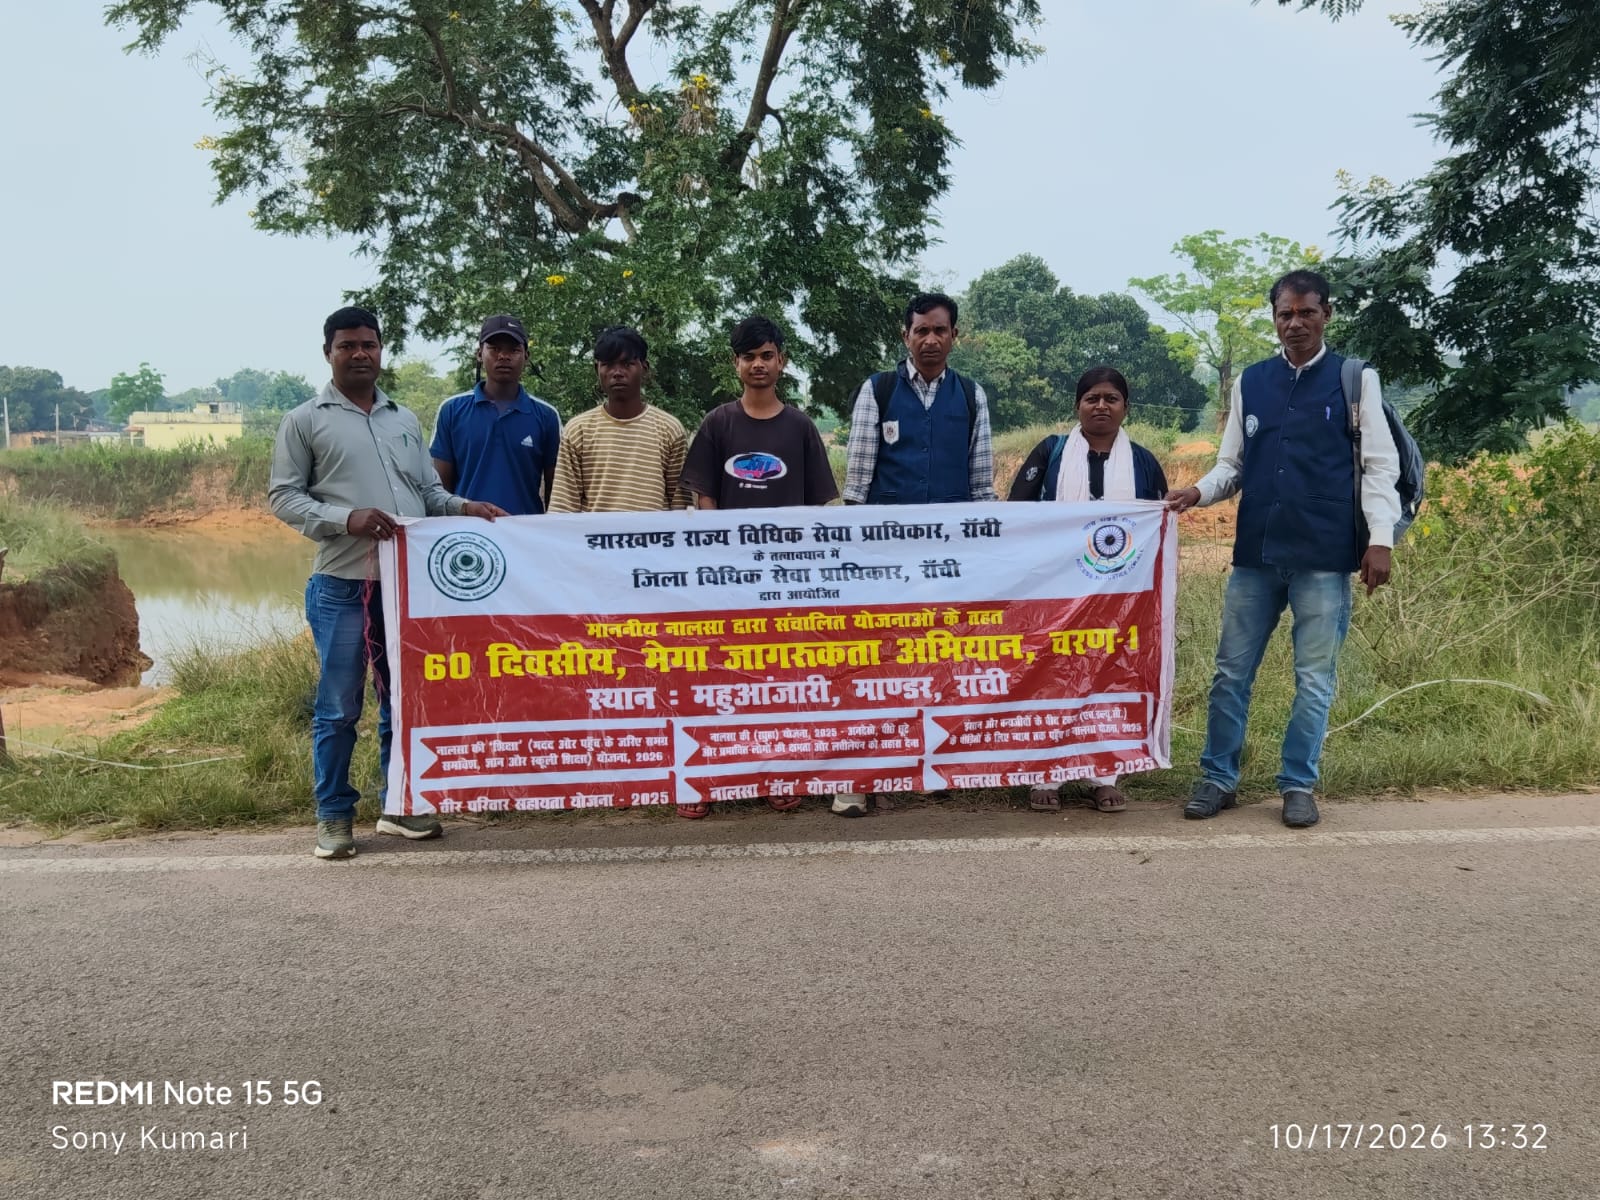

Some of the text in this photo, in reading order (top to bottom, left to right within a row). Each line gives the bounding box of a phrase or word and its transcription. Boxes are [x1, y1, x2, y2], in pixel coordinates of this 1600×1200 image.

[585, 532, 675, 550] झारखण्ड
[682, 530, 731, 547] राज्य
[738, 524, 804, 545] विधिक
[812, 523, 852, 542] सेवा
[861, 521, 950, 542] प्राधिकार,
[752, 550, 765, 562] के
[830, 547, 841, 560] में
[632, 568, 688, 588] जिला
[696, 566, 762, 586] विधिक
[770, 565, 811, 583] सेवा
[819, 562, 910, 583] प्राधिकार,
[787, 587, 840, 600] आयोजित
[586, 608, 1004, 638] माननीय नालसा द्वारा संचालित योजनाओं के तहत
[424, 652, 471, 680] 60
[486, 642, 627, 681] दिवसीय,
[641, 640, 710, 672] मेगा
[896, 630, 1036, 665] अभियान,
[1049, 626, 1139, 656] चरण-1
[586, 686, 657, 711] स्थान
[691, 674, 841, 715] महुआंजारी,
[852, 676, 942, 703] माण्डर,
[954, 667, 1011, 697] रांची
[436, 744, 469, 756] नालसा
[471, 741, 486, 753] की
[558, 737, 577, 749] और
[603, 736, 614, 747] के
[709, 732, 737, 742] नालसा
[739, 729, 750, 741] की
[508, 754, 527, 767] और
[596, 751, 631, 764] योजना,
[952, 773, 1002, 788] नालसा
[1007, 768, 1046, 786] संवाद
[1049, 764, 1096, 781] योजना
[1114, 757, 1155, 775] 2025
[709, 784, 759, 801] नालसा
[805, 777, 855, 795] योजना
[873, 777, 913, 793] 2025
[439, 798, 463, 813] वीर
[467, 796, 510, 812] परिवार
[515, 796, 566, 810] सहायता
[569, 792, 614, 809] योजना
[631, 791, 669, 806] 2025
